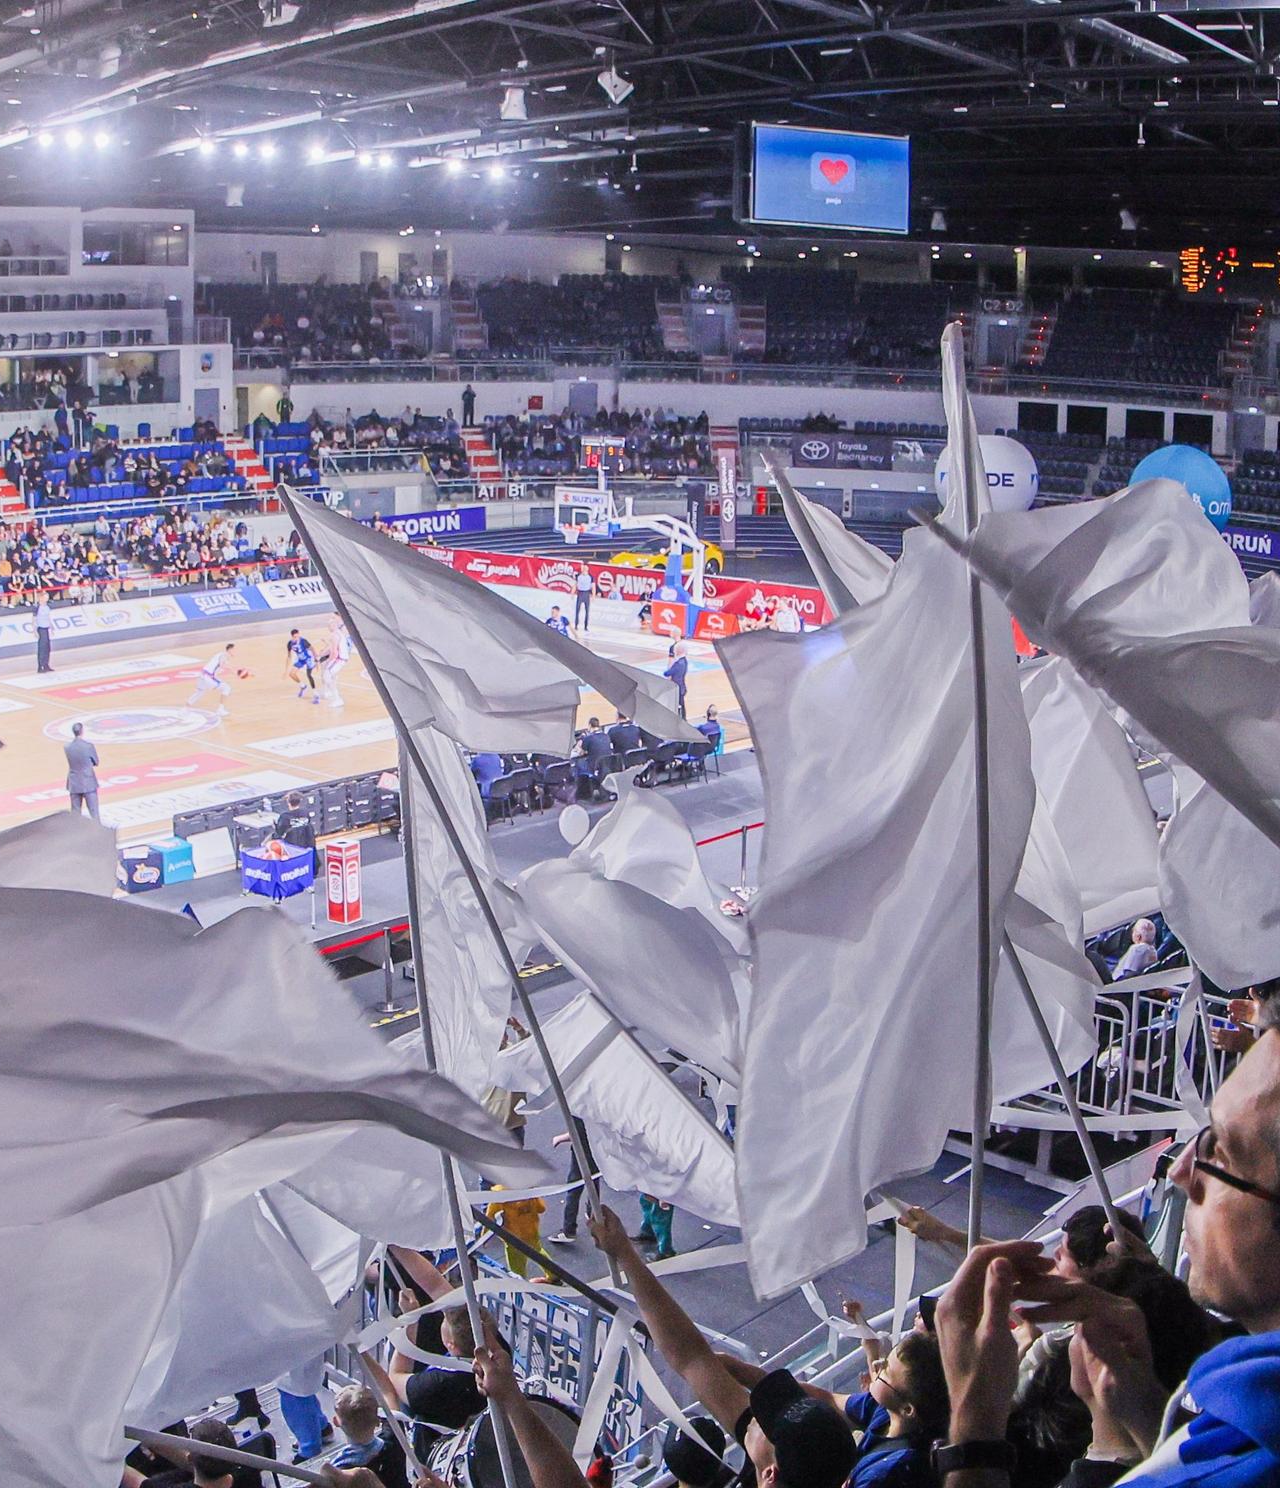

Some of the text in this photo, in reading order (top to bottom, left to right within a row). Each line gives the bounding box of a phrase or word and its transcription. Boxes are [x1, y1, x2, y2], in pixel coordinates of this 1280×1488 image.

[837, 441, 868, 452] Toyota
[986, 472, 1015, 487] DE
[322, 490, 344, 506] VIP
[477, 484, 525, 498] A1 B1
[571, 494, 605, 505] SUZUKI
[394, 511, 461, 536] TORUŃ
[1221, 532, 1272, 555] ORUŃ
[290, 577, 326, 597] PAW
[244, 866, 272, 881] molten
[280, 864, 310, 881] molten
